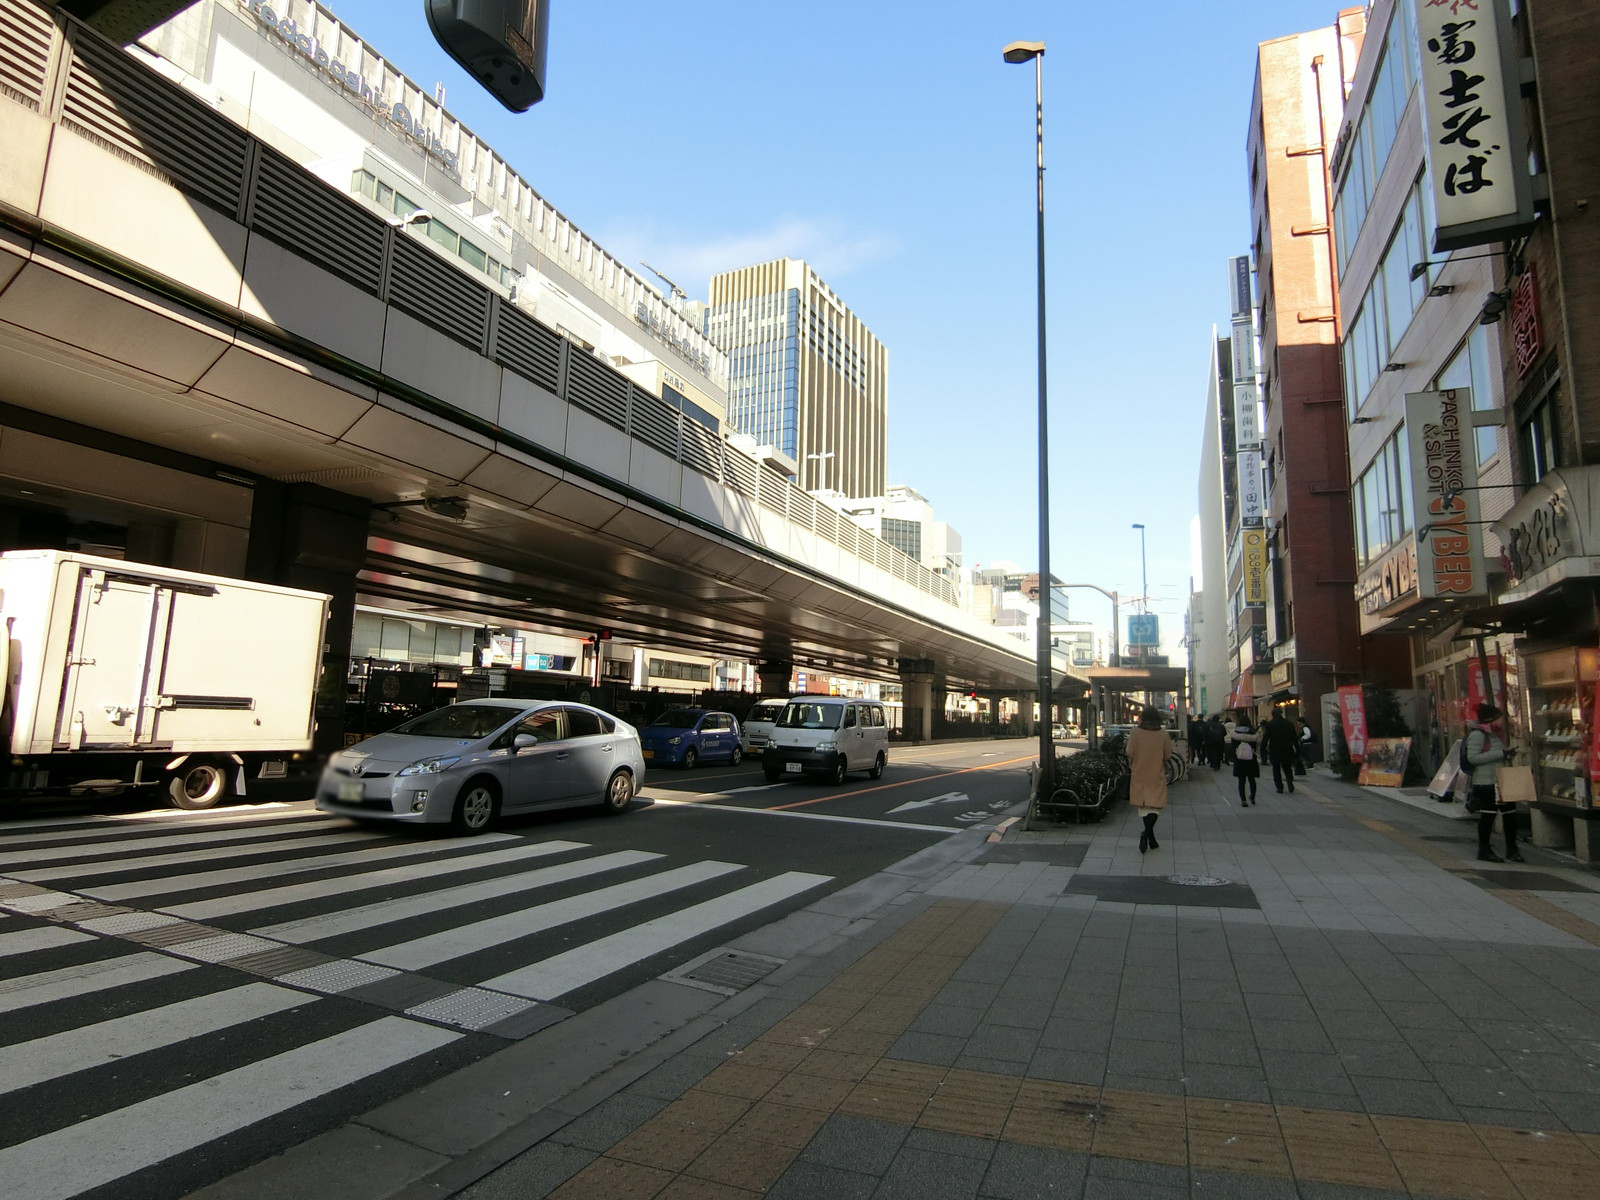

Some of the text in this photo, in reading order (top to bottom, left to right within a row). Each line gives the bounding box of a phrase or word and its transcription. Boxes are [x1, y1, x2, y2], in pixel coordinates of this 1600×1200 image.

[1428, 20, 1500, 197] 富士そば
[1241, 391, 1254, 439] 小柳歯科
[1438, 388, 1464, 496] PACHINKO
[1247, 517, 1258, 525] 2F
[1428, 497, 1473, 596] CYBER
